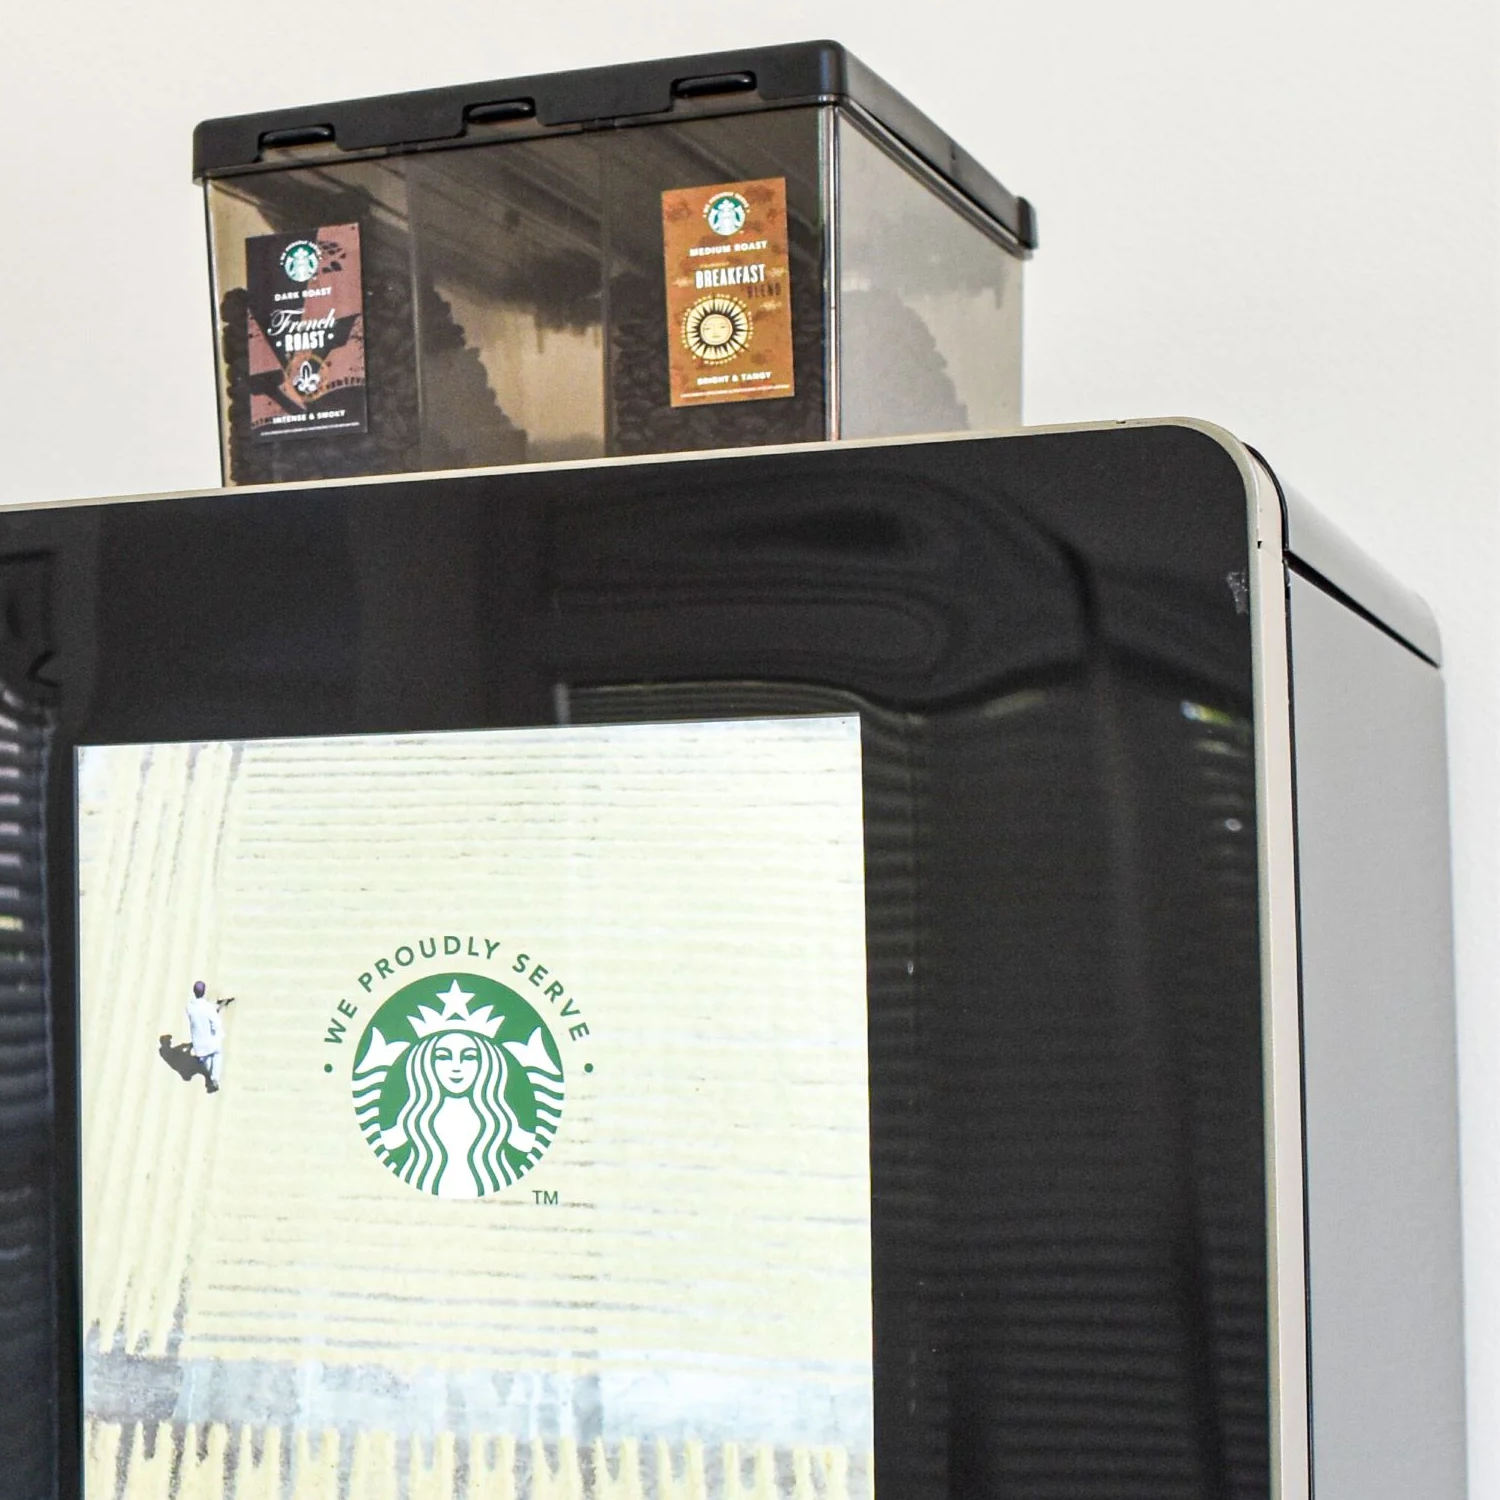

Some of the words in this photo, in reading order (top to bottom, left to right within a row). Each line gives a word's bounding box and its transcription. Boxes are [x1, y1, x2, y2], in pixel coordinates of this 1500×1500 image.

[689, 245, 731, 256] MEDIUM
[733, 240, 768, 252] ROAST
[695, 264, 766, 289] BREAKFAST
[274, 291, 300, 302] DARK
[302, 287, 332, 298] ROAST
[267, 308, 336, 336] French
[284, 330, 325, 352] ROAST
[324, 998, 358, 1045] WE
[357, 935, 501, 993] PROUDLY
[512, 953, 591, 1041] SERVE
[532, 1190, 559, 1205] TM
